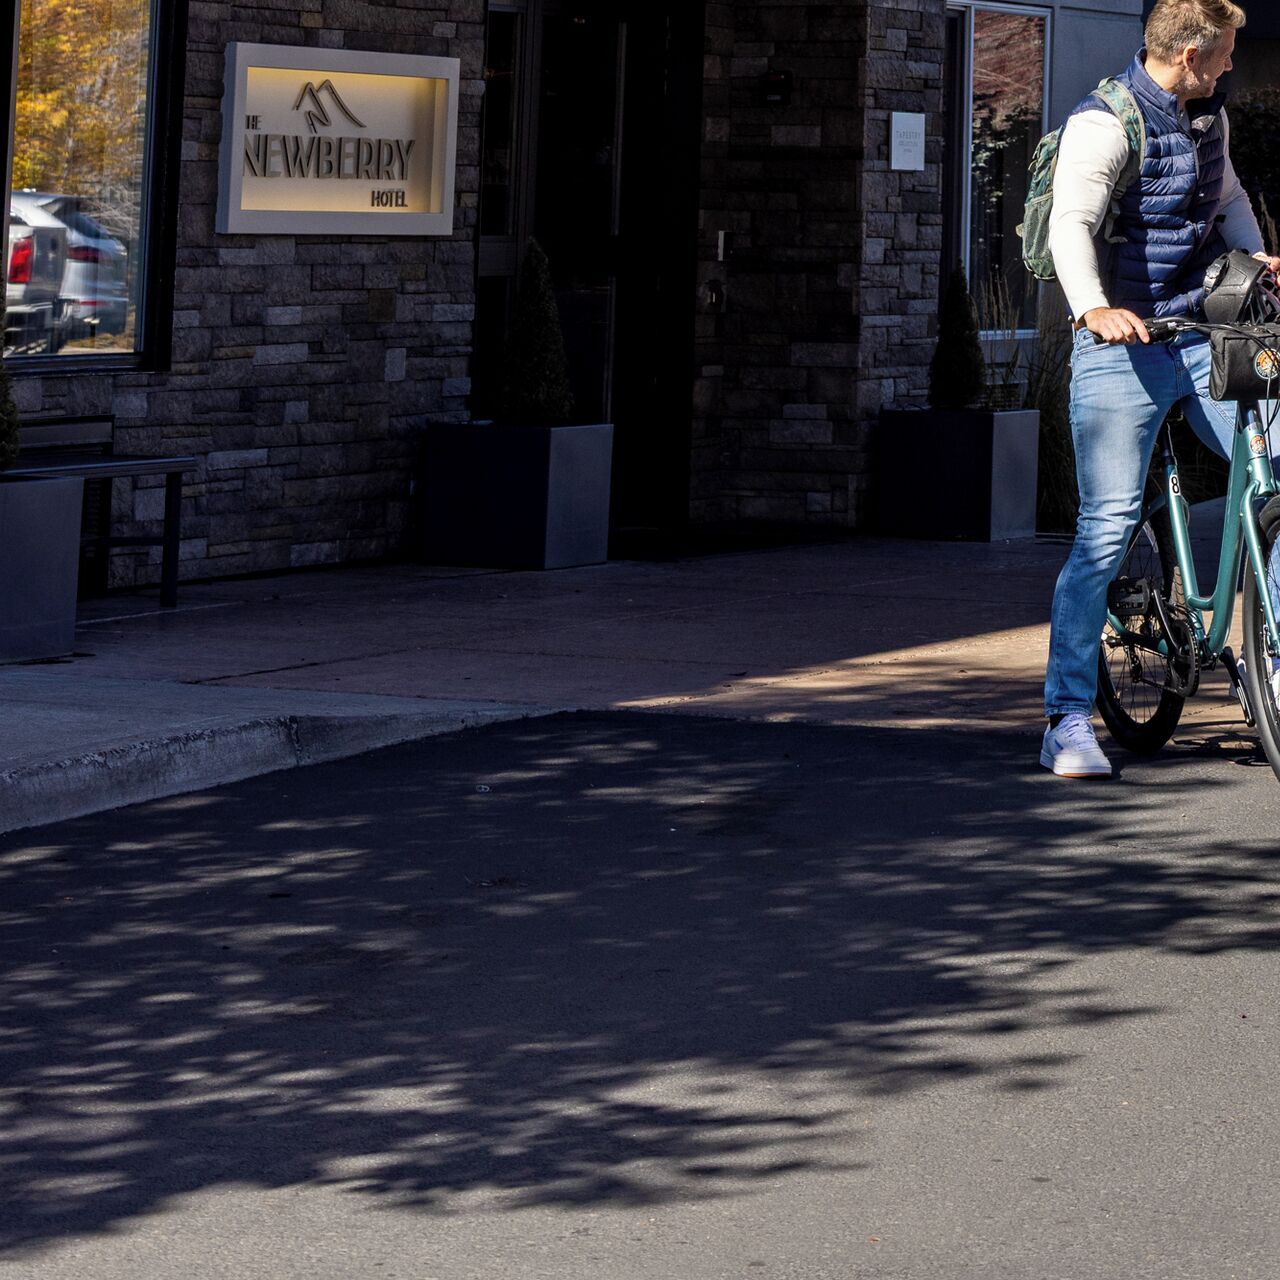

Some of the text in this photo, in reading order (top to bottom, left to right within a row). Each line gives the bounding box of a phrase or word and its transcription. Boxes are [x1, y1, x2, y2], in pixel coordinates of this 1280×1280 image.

[245, 114, 262, 130] THE
[243, 134, 416, 180] NEWBERRY
[371, 190, 408, 207] HOTEL
[1171, 476, 1179, 494] 8
